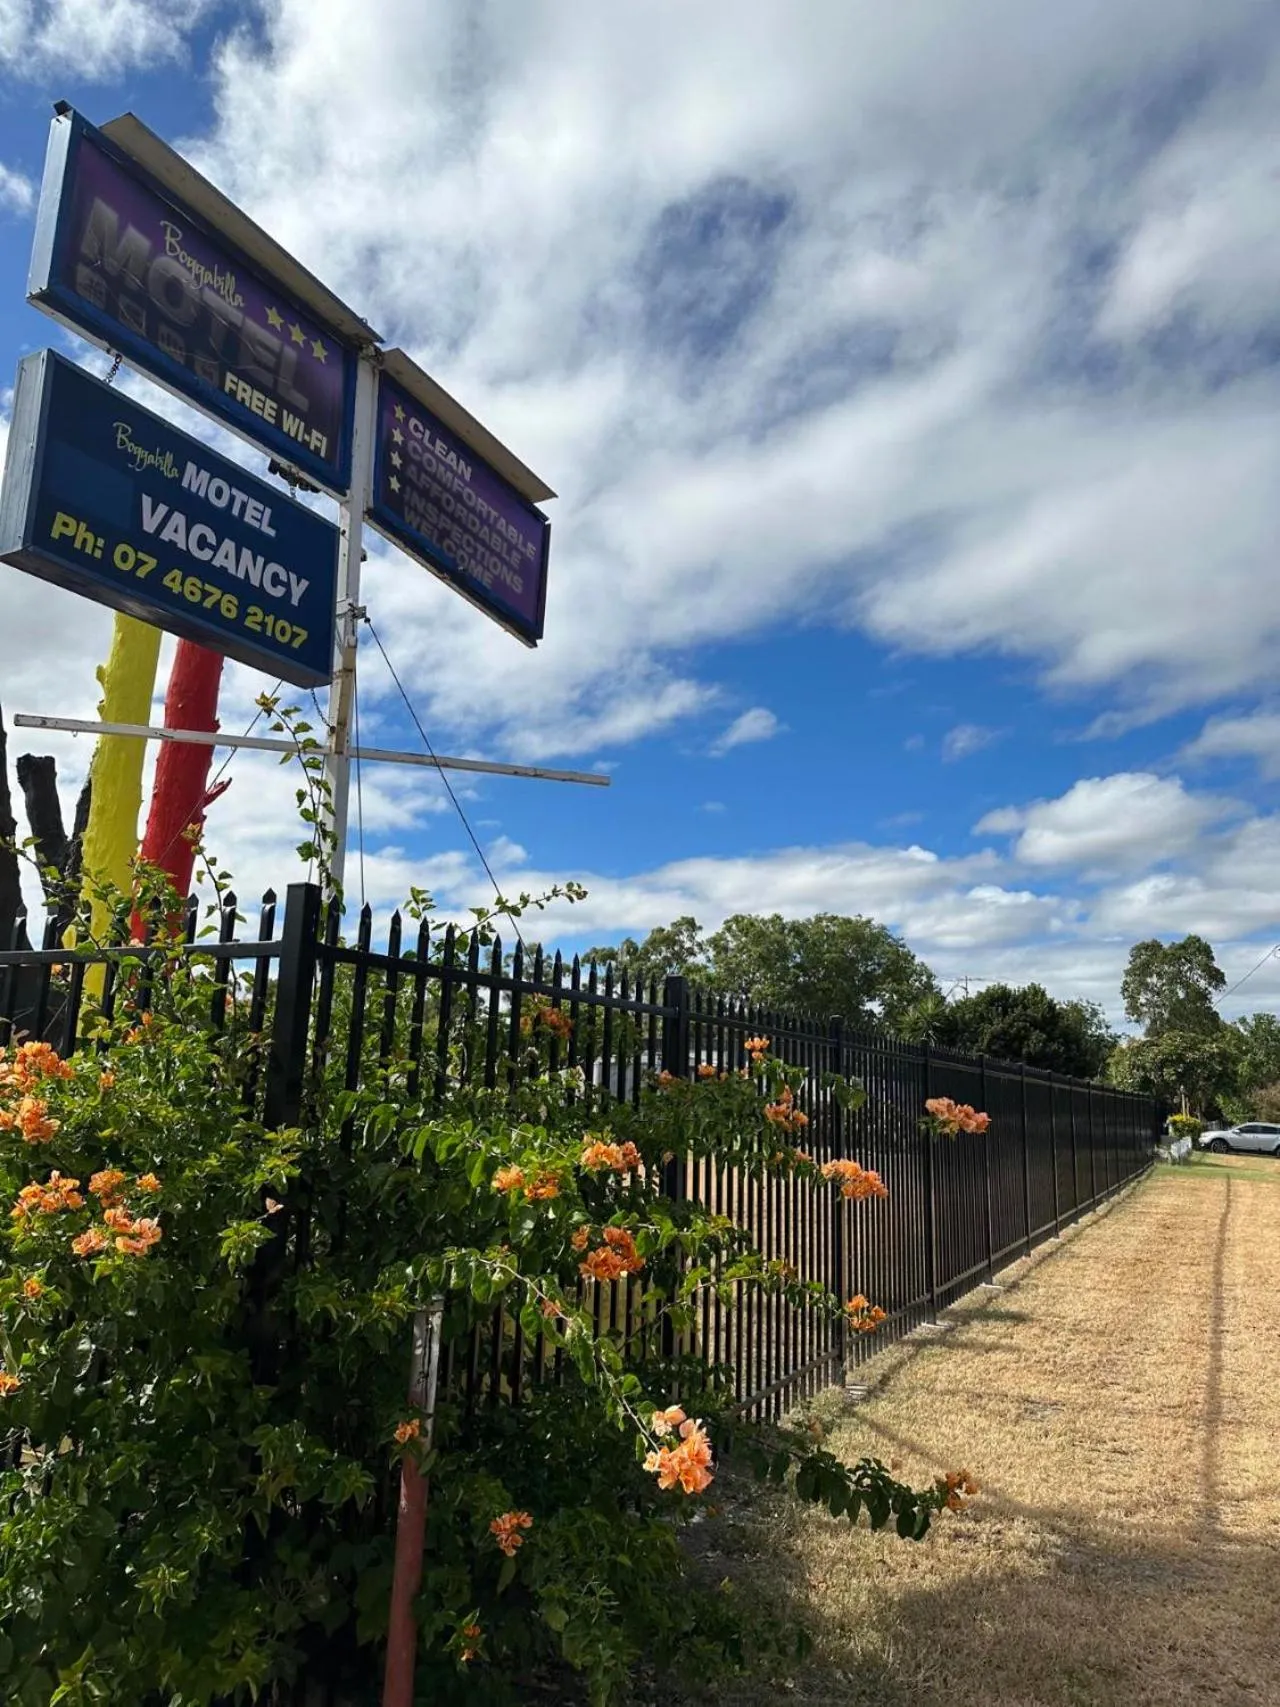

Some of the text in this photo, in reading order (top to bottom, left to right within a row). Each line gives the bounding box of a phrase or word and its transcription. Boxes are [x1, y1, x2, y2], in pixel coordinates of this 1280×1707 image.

[81, 197, 309, 411] MOTEL
[160, 220, 244, 307] Boggabilla
[224, 372, 327, 458] FREE WI-FI
[408, 417, 472, 480] CLEAN
[113, 421, 277, 537] Boggabilla MOTEL
[405, 465, 523, 571] AFFORDABLE
[407, 440, 537, 561] COMFORTABLE
[50, 511, 309, 649] Ph: 07 4676 2107
[141, 494, 310, 607] VACANCY
[403, 486, 524, 595] INSPECTIONS
[403, 505, 495, 589] WELCOME
